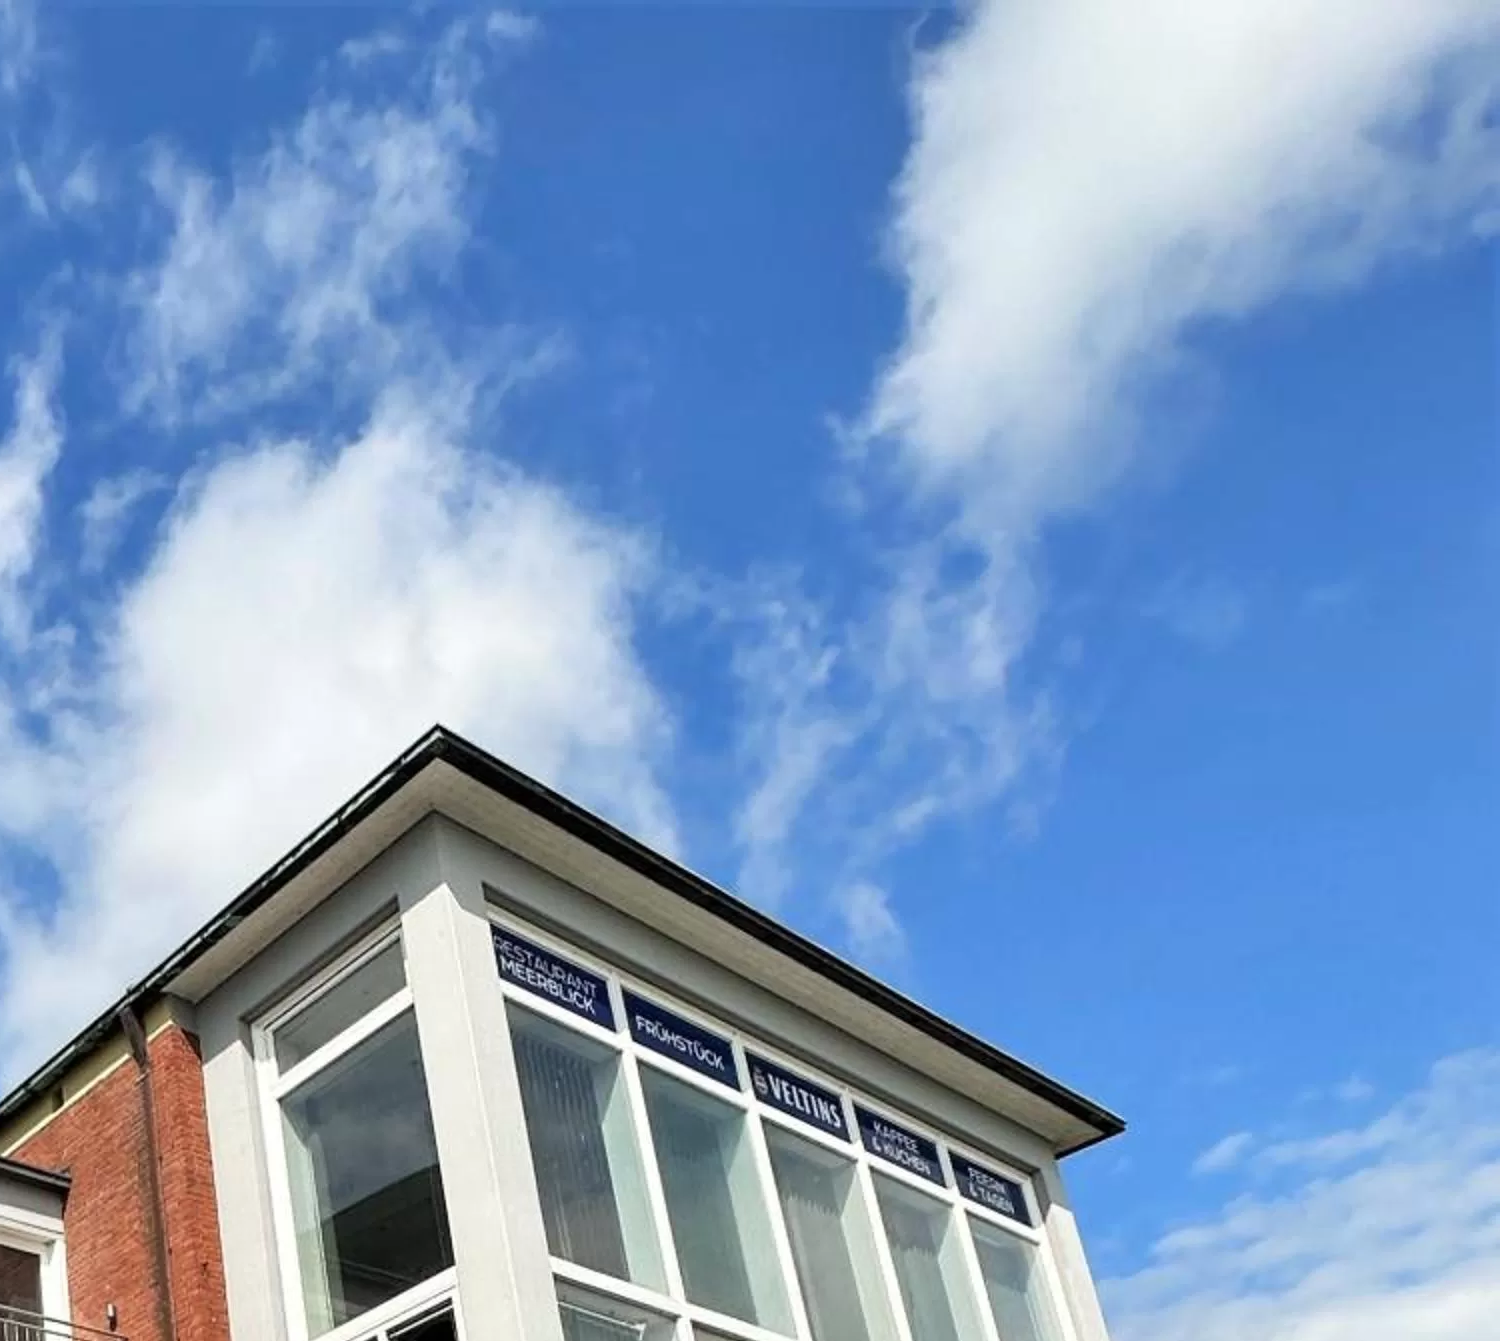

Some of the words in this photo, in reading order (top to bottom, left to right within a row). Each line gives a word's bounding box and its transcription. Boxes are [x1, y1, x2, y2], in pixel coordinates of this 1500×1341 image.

[493, 935, 598, 998] RESTAURANT
[499, 955, 598, 1017] MEERBLICK
[635, 1015, 726, 1072] FRÜHSTÜCK
[767, 1072, 842, 1129] VELTINS
